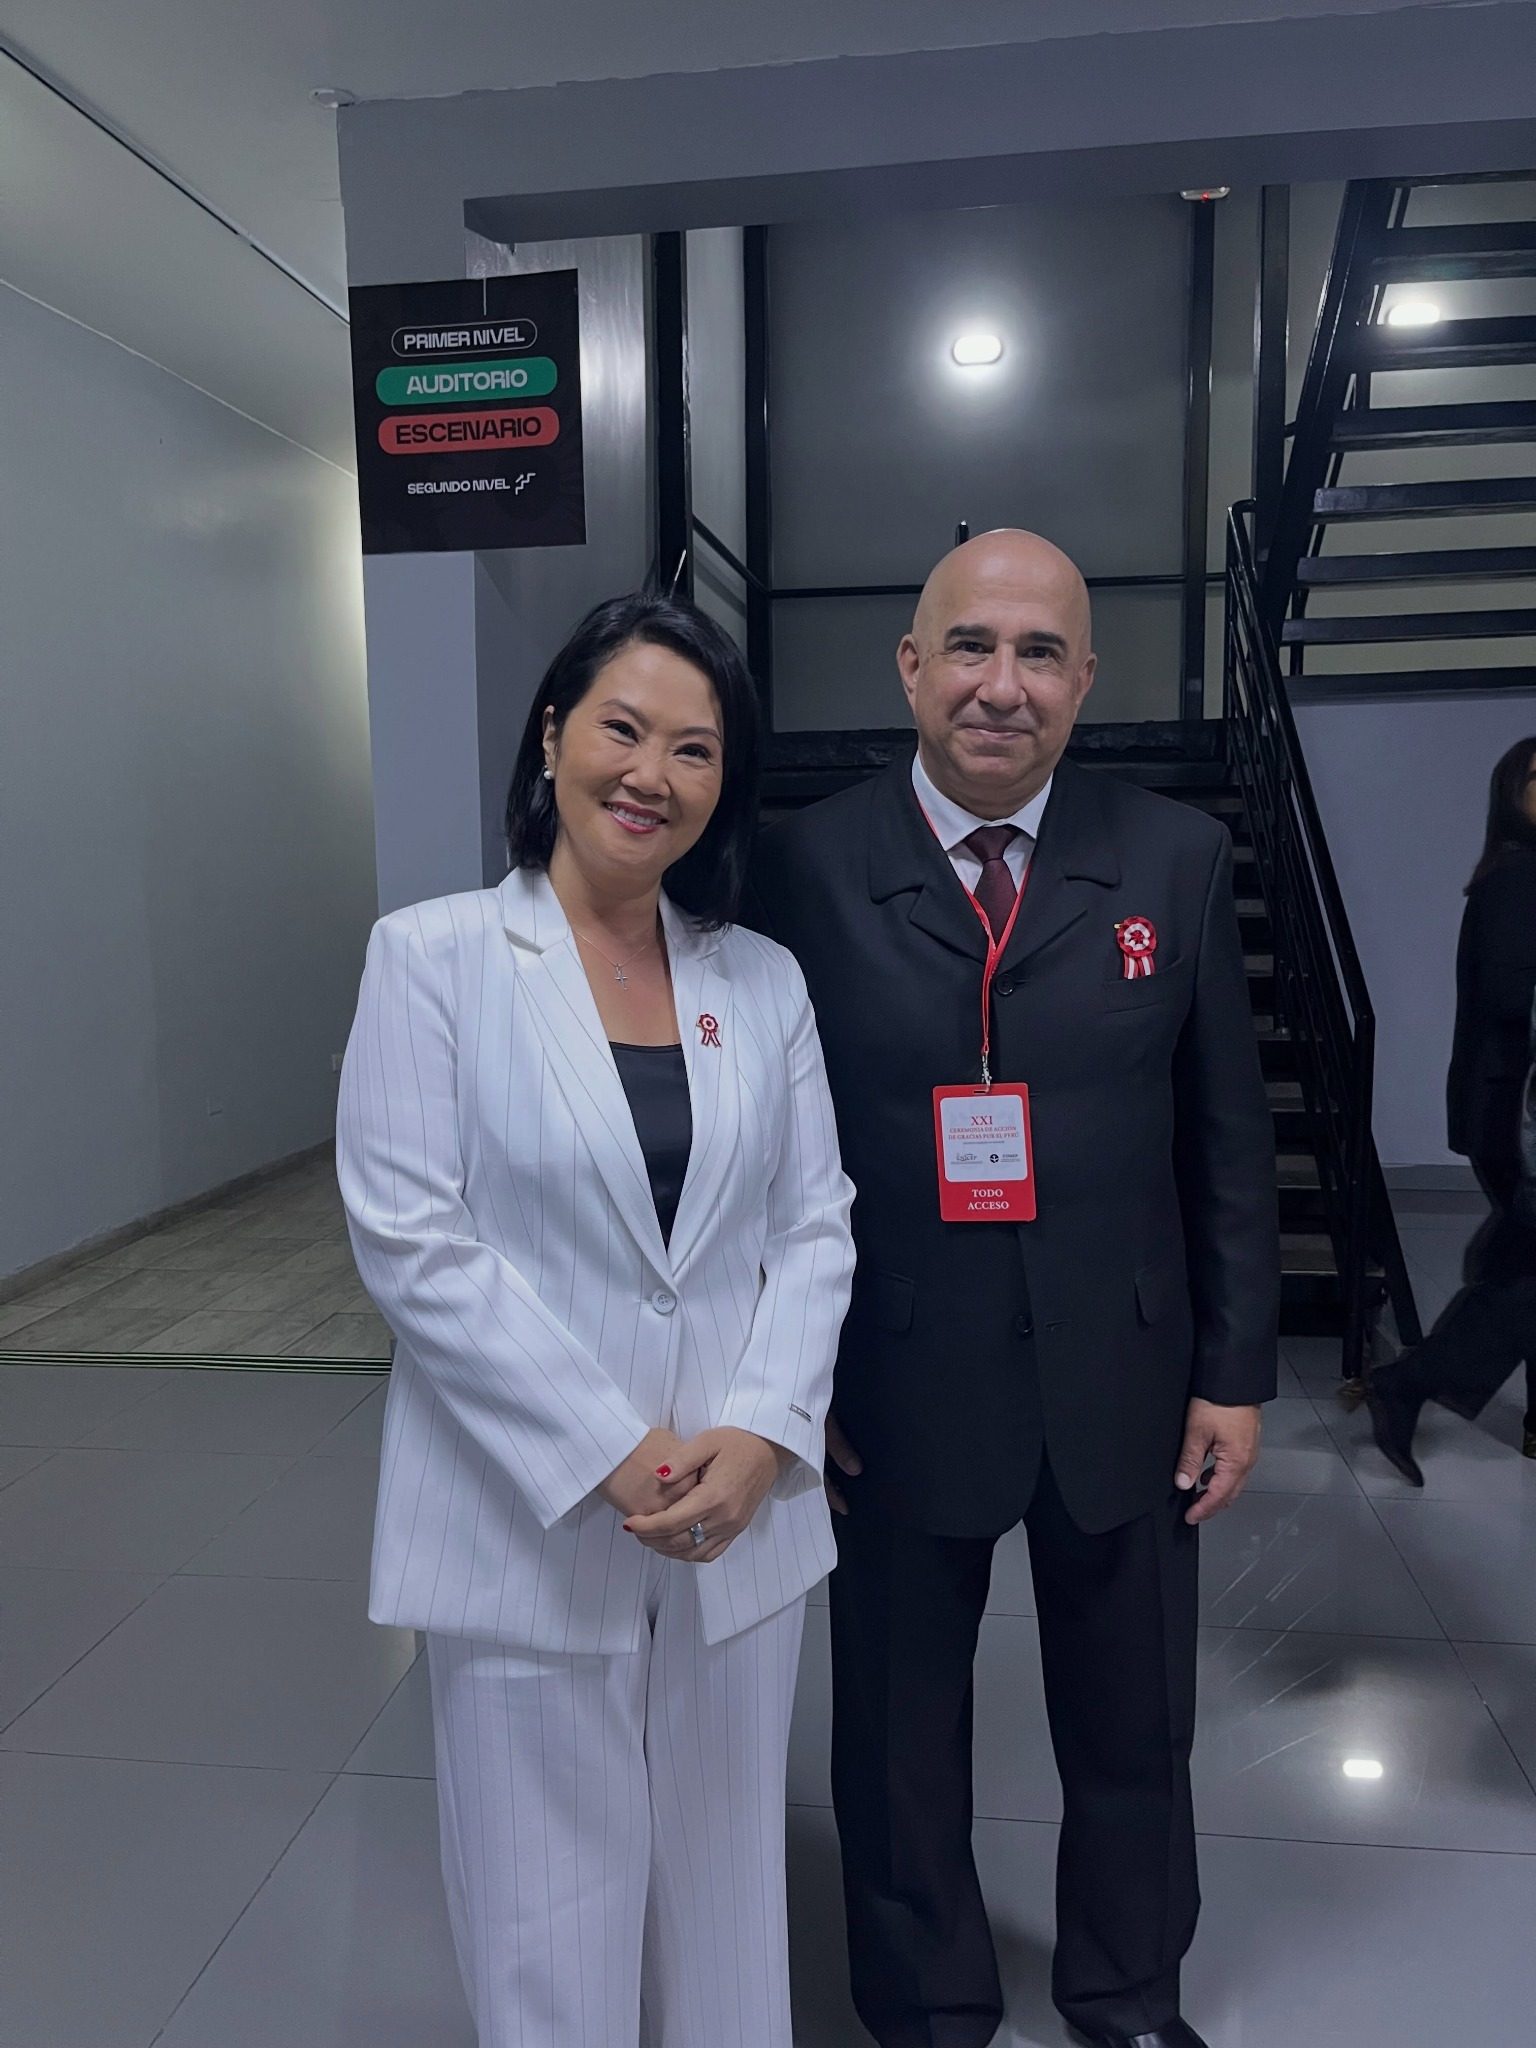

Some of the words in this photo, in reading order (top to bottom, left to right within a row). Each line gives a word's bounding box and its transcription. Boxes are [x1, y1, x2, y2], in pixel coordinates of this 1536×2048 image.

[404, 331, 470, 350] PRIMER
[474, 327, 525, 346] NIVEL
[406, 369, 528, 395] AUDITORIO
[396, 416, 542, 444] ESCENARIO
[407, 480, 471, 495] SEGUNDO
[473, 478, 511, 491] NIVEL
[971, 1115, 993, 1126] XXI
[972, 1189, 1003, 1198] TODO
[967, 1201, 1010, 1210] ACCESO
